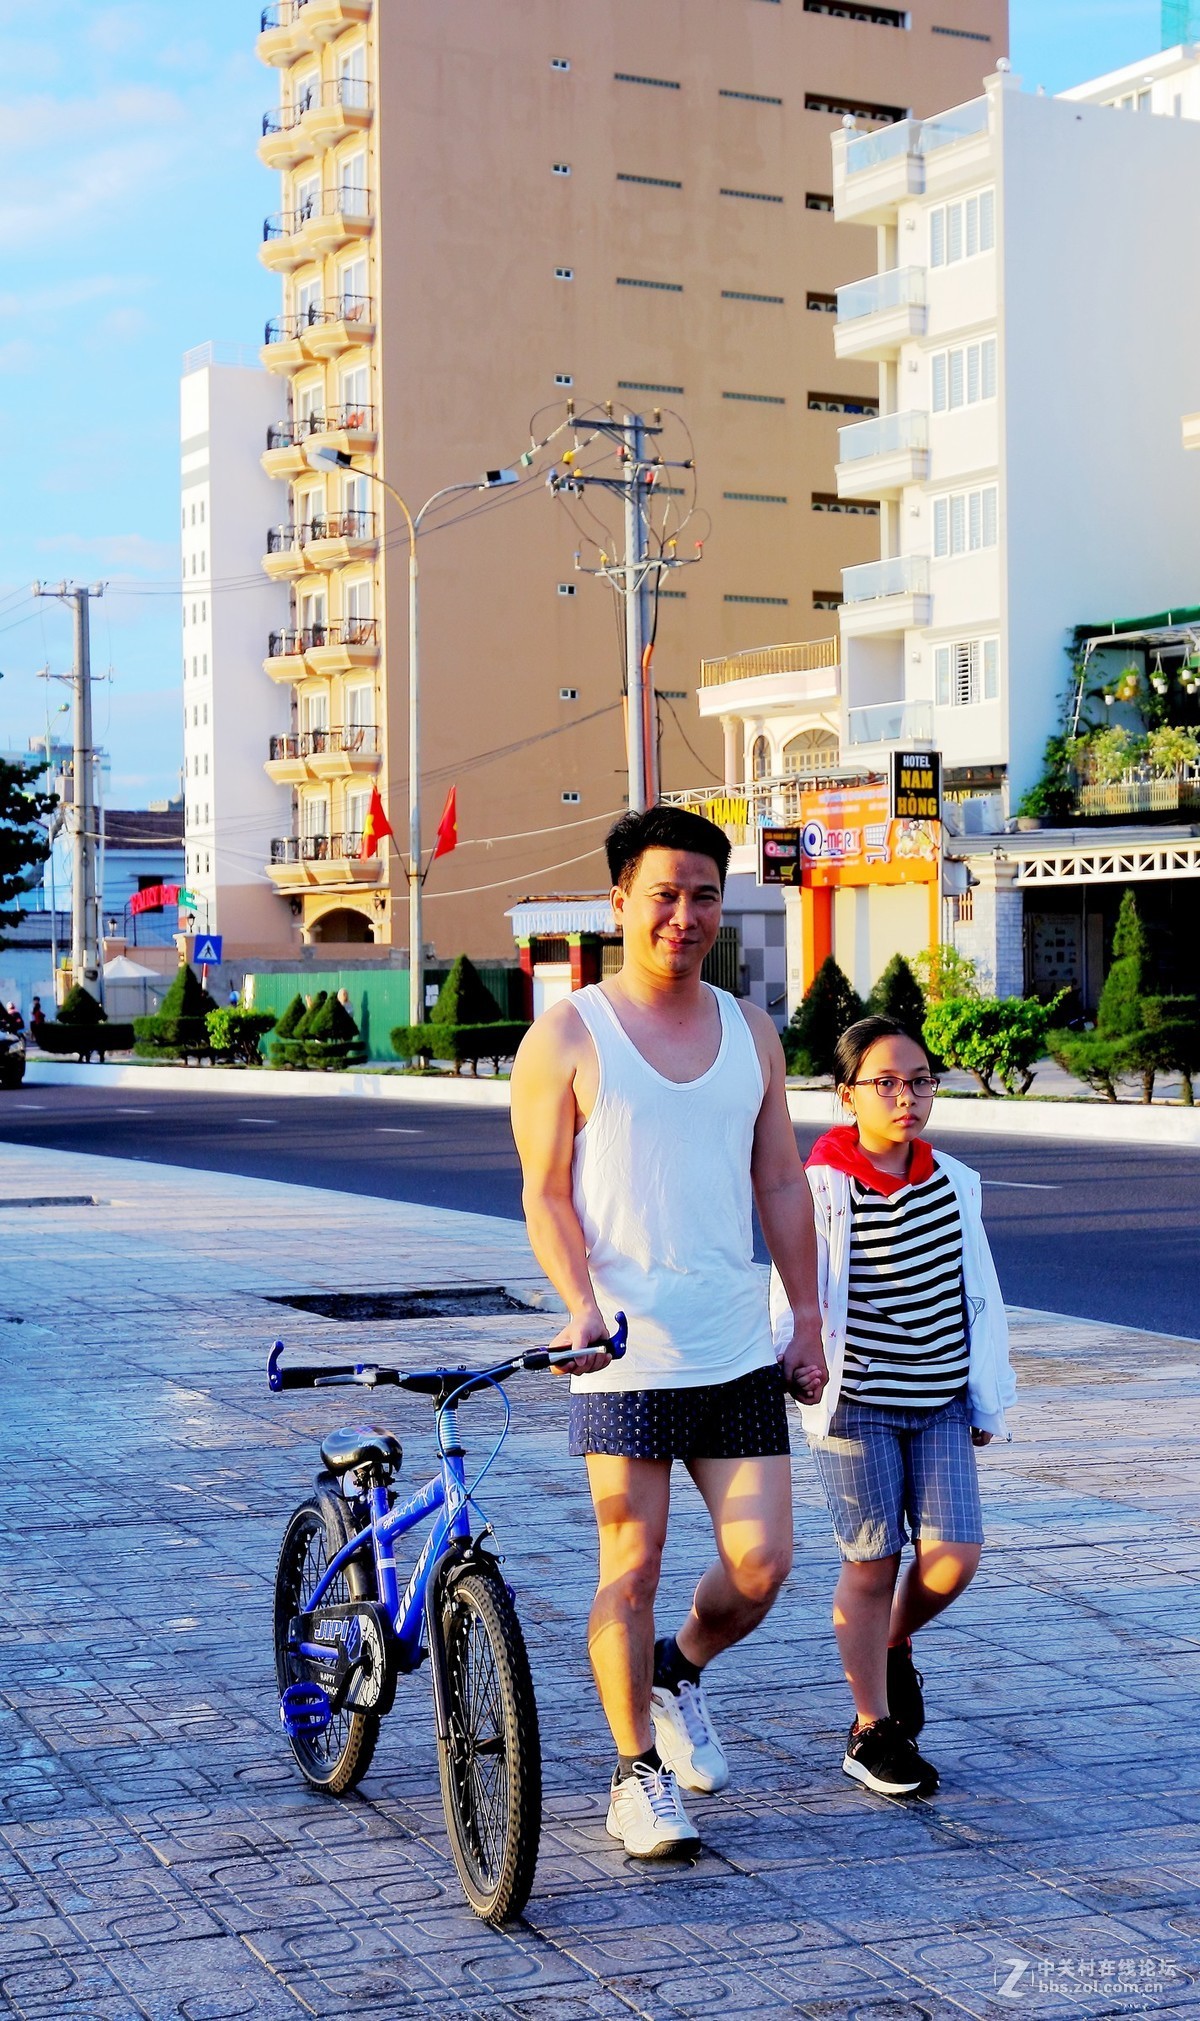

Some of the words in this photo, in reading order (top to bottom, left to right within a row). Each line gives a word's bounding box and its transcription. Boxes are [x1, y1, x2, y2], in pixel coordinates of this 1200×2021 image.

[902, 755, 931, 768] HOTEL
[900, 769, 933, 789] NAM
[897, 789, 937, 816] HỒNG
[314, 1619, 349, 1641] JIPI
